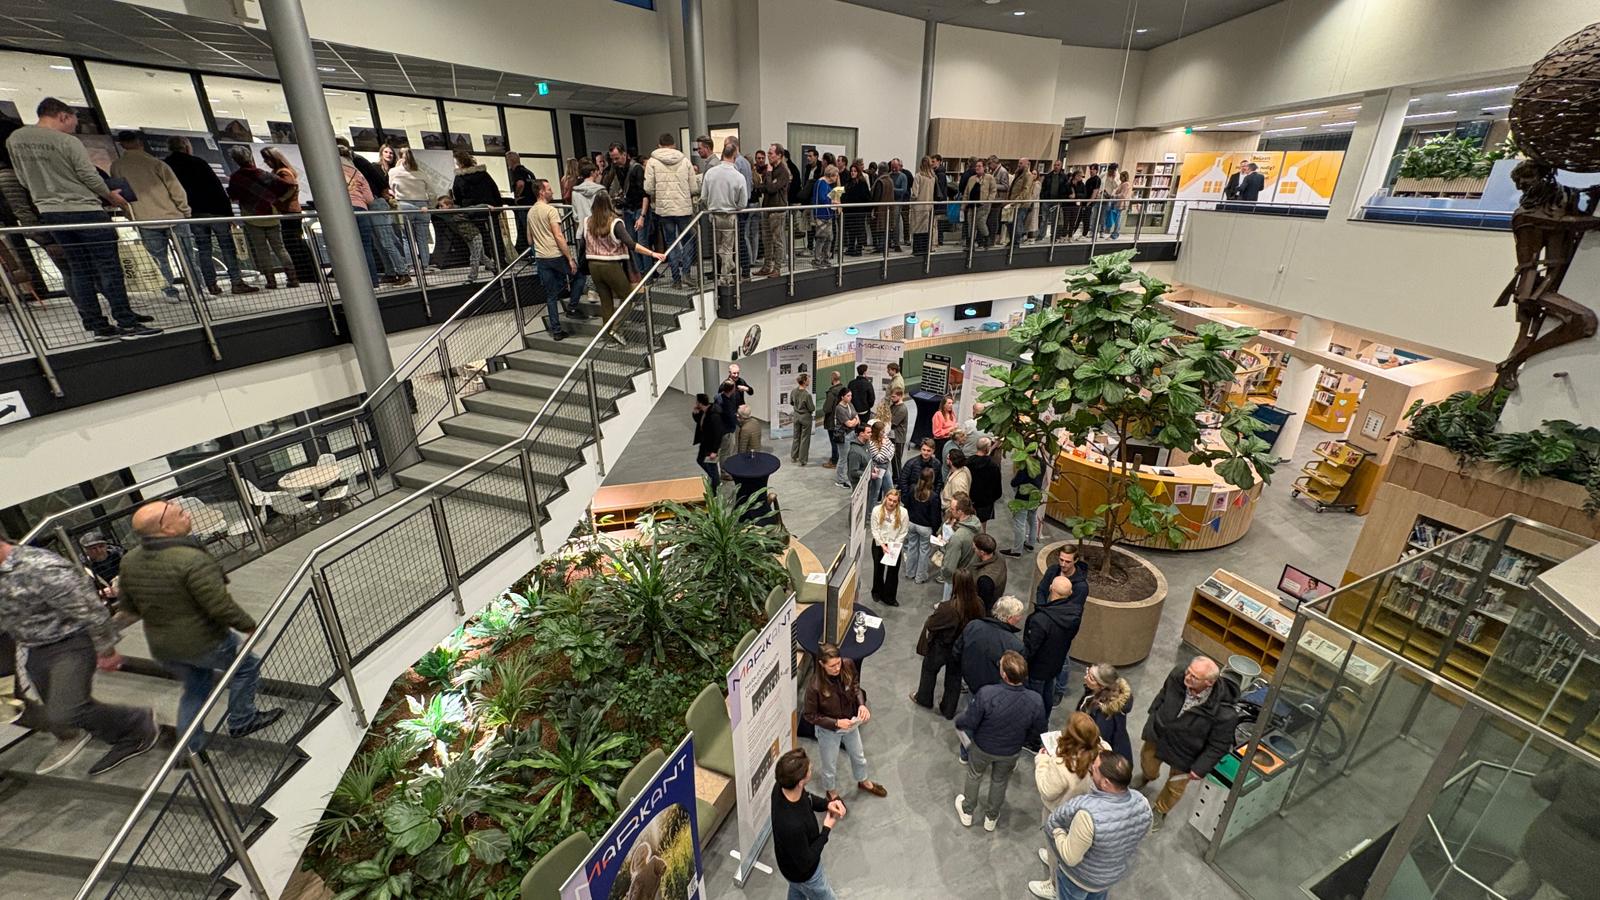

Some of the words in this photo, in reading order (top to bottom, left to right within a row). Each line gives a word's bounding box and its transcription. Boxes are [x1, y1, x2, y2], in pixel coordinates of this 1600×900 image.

[968, 358, 992, 367] MARK
[733, 609, 792, 691] MARKANT
[575, 754, 687, 900] MARKANT
